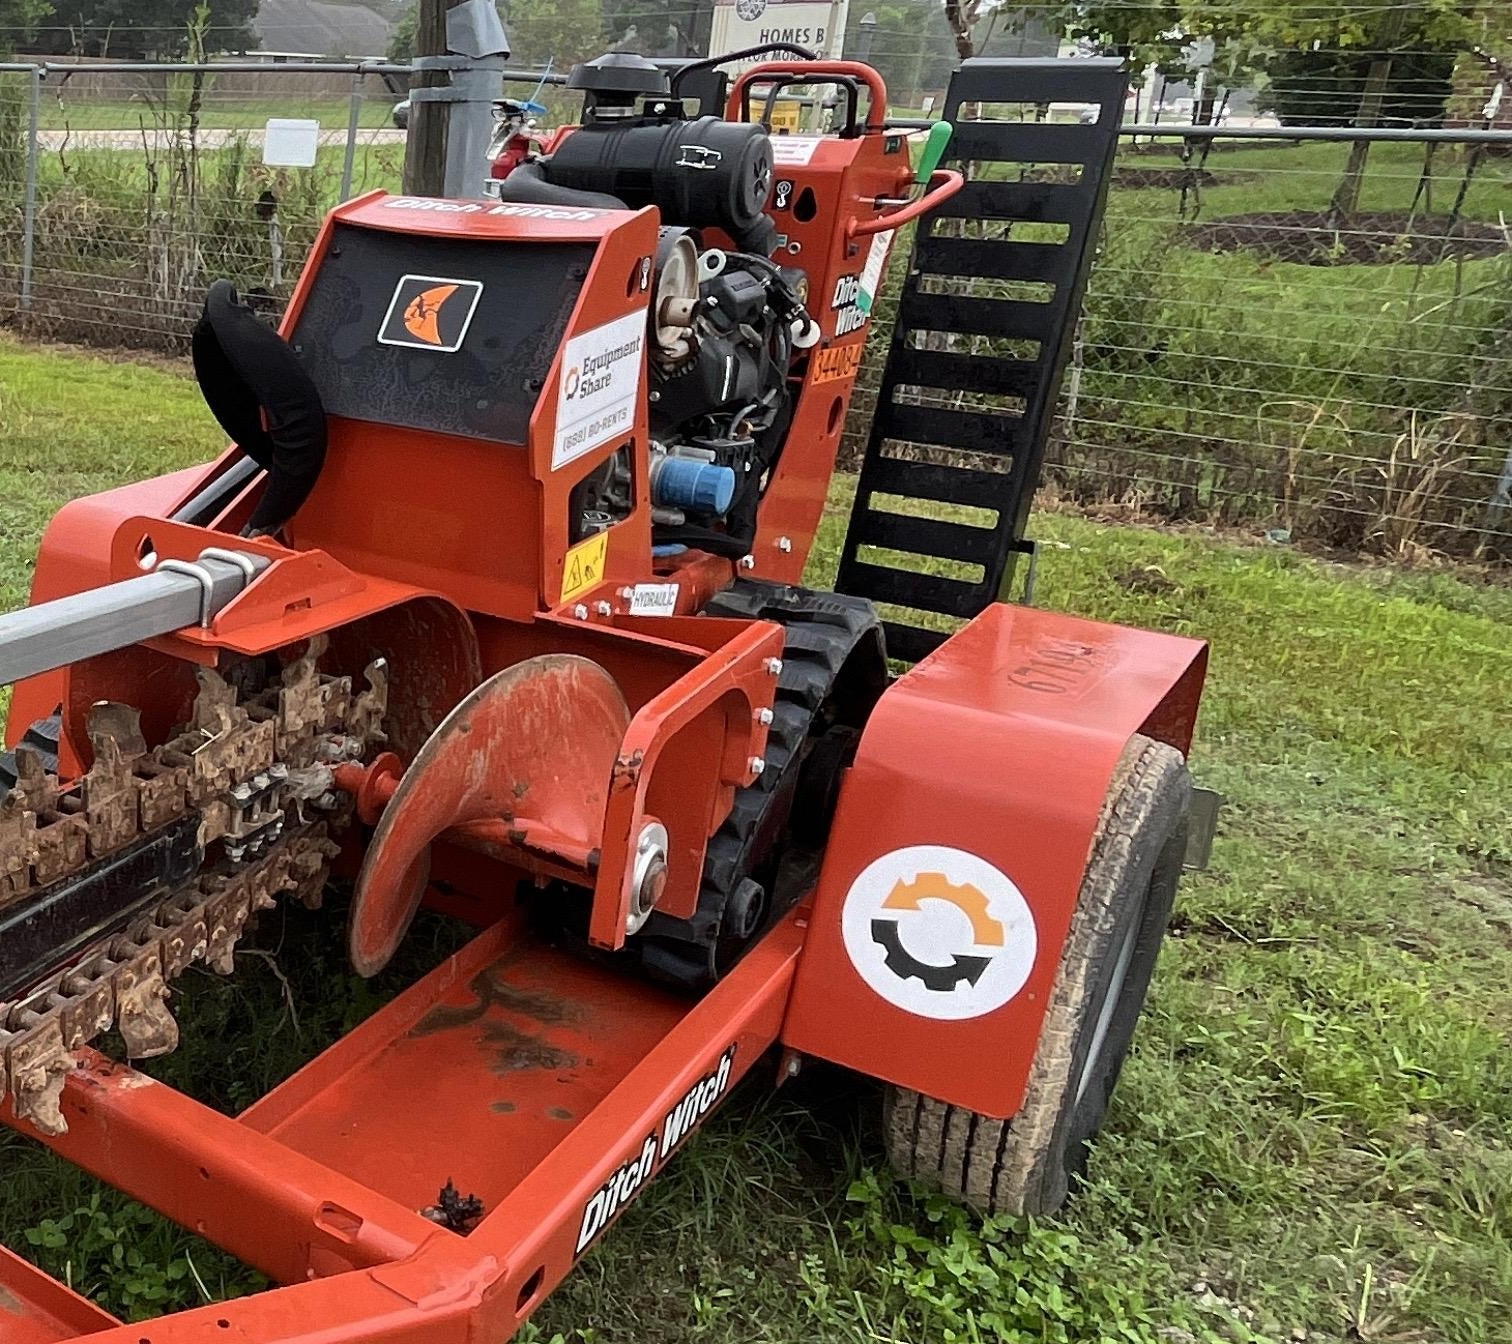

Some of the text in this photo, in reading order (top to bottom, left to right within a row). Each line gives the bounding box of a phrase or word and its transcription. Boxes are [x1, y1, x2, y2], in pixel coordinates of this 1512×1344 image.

[760, 28, 810, 44] HOMES
[385, 198, 597, 222] Ditch Witch
[581, 334, 641, 377] Equipment
[579, 372, 612, 400] Share
[633, 589, 675, 608] HYDRAULIC
[576, 1054, 732, 1254] Ditch Witch
